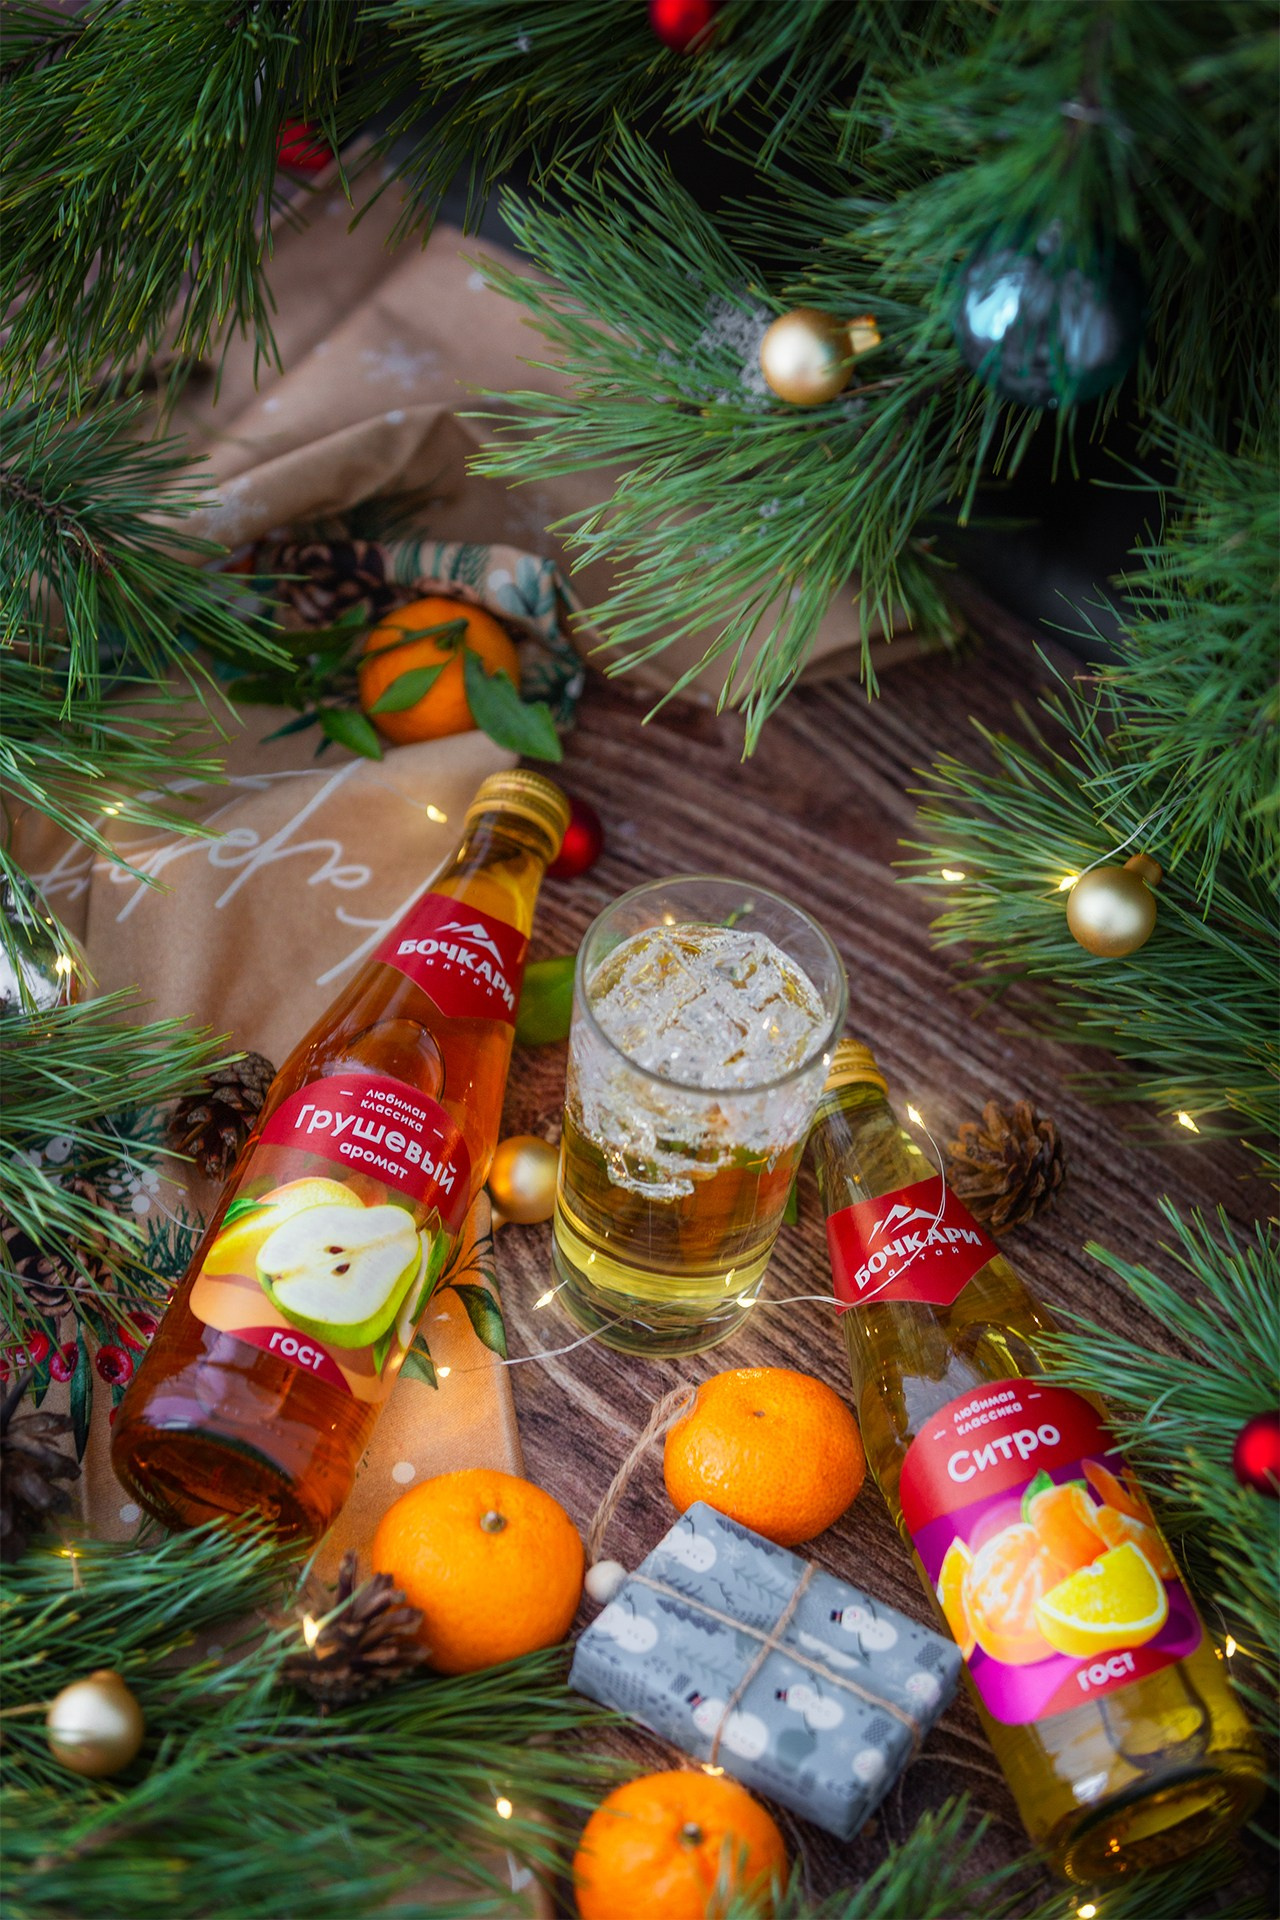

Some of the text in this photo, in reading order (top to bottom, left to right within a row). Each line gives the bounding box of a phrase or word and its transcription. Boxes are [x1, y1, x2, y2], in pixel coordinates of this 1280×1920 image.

[397, 939, 515, 1011] БОЧКАРИ
[360, 1099, 424, 1133] классика
[366, 1089, 427, 1121] любимая
[294, 1104, 457, 1195] Грушевый
[339, 1142, 408, 1180] аромат
[854, 1227, 983, 1291] БОЧКАРИ
[953, 1390, 1016, 1423] любимая
[956, 1402, 1023, 1436] классика
[947, 1424, 1061, 1483] Ситро
